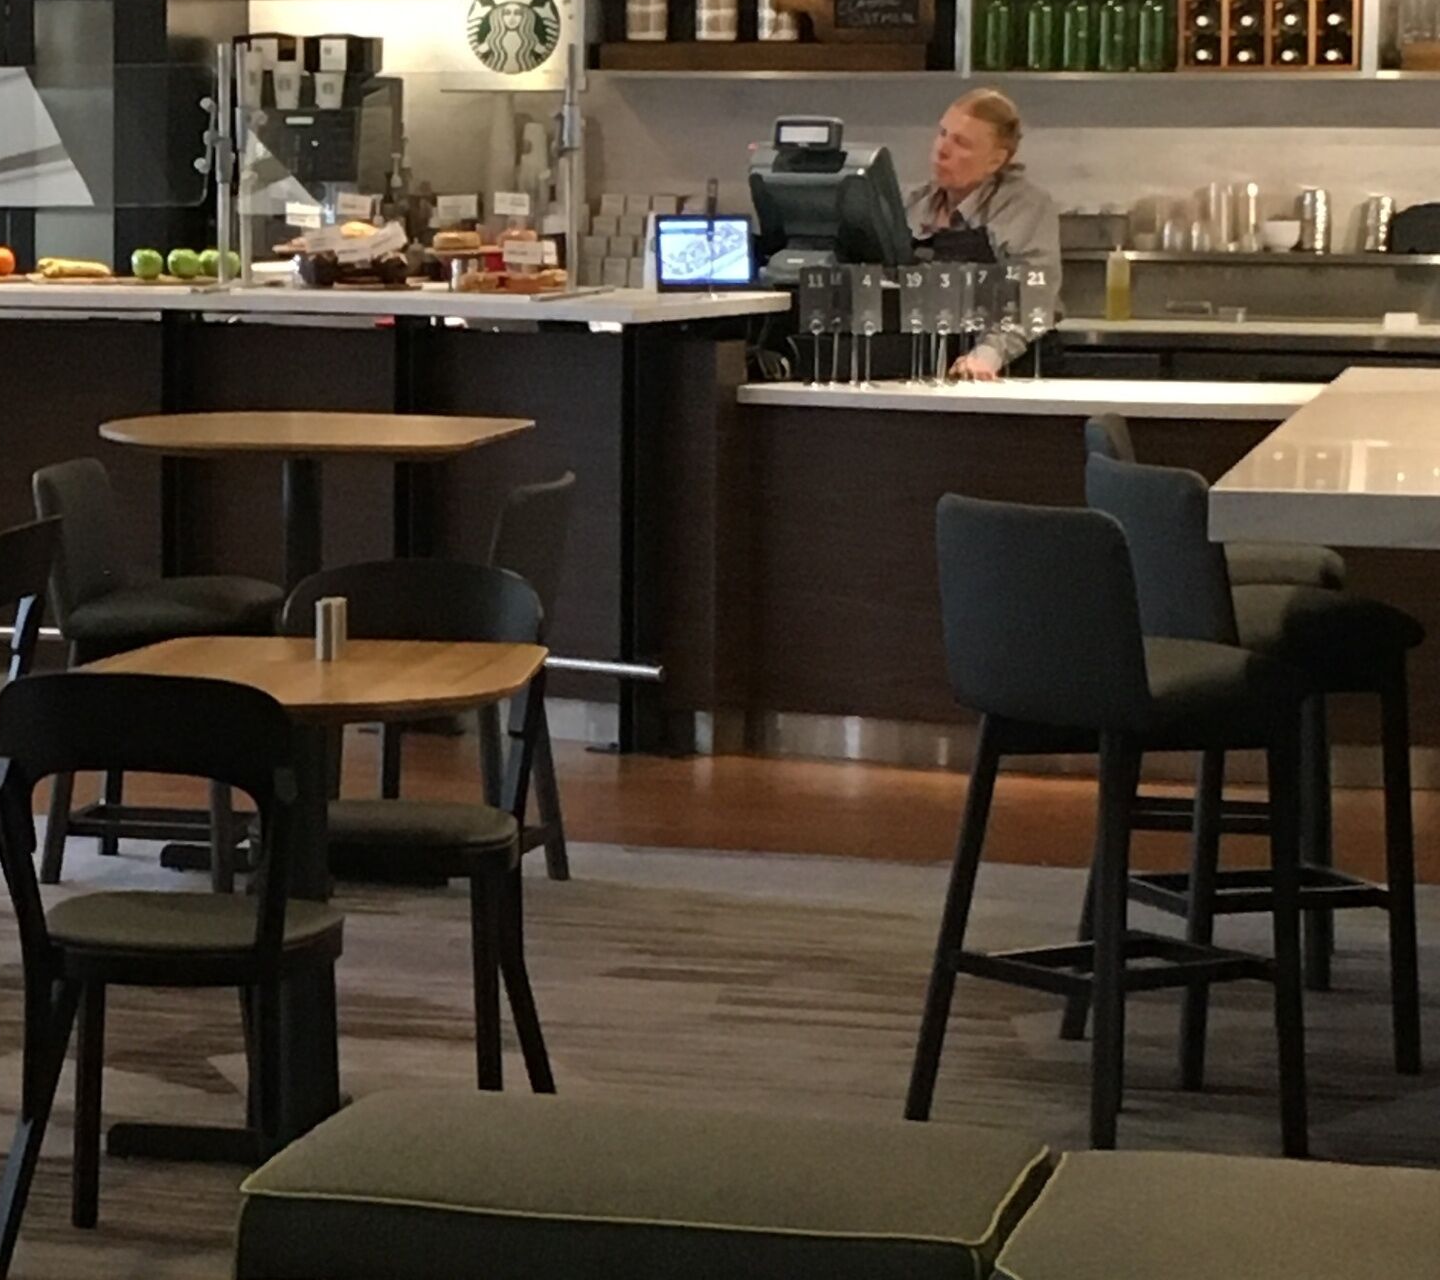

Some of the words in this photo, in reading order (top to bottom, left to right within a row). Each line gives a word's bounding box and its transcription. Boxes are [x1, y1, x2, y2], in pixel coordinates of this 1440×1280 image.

[862, 273, 872, 288] 4
[940, 273, 951, 288] 3
[1027, 271, 1047, 286] 21
